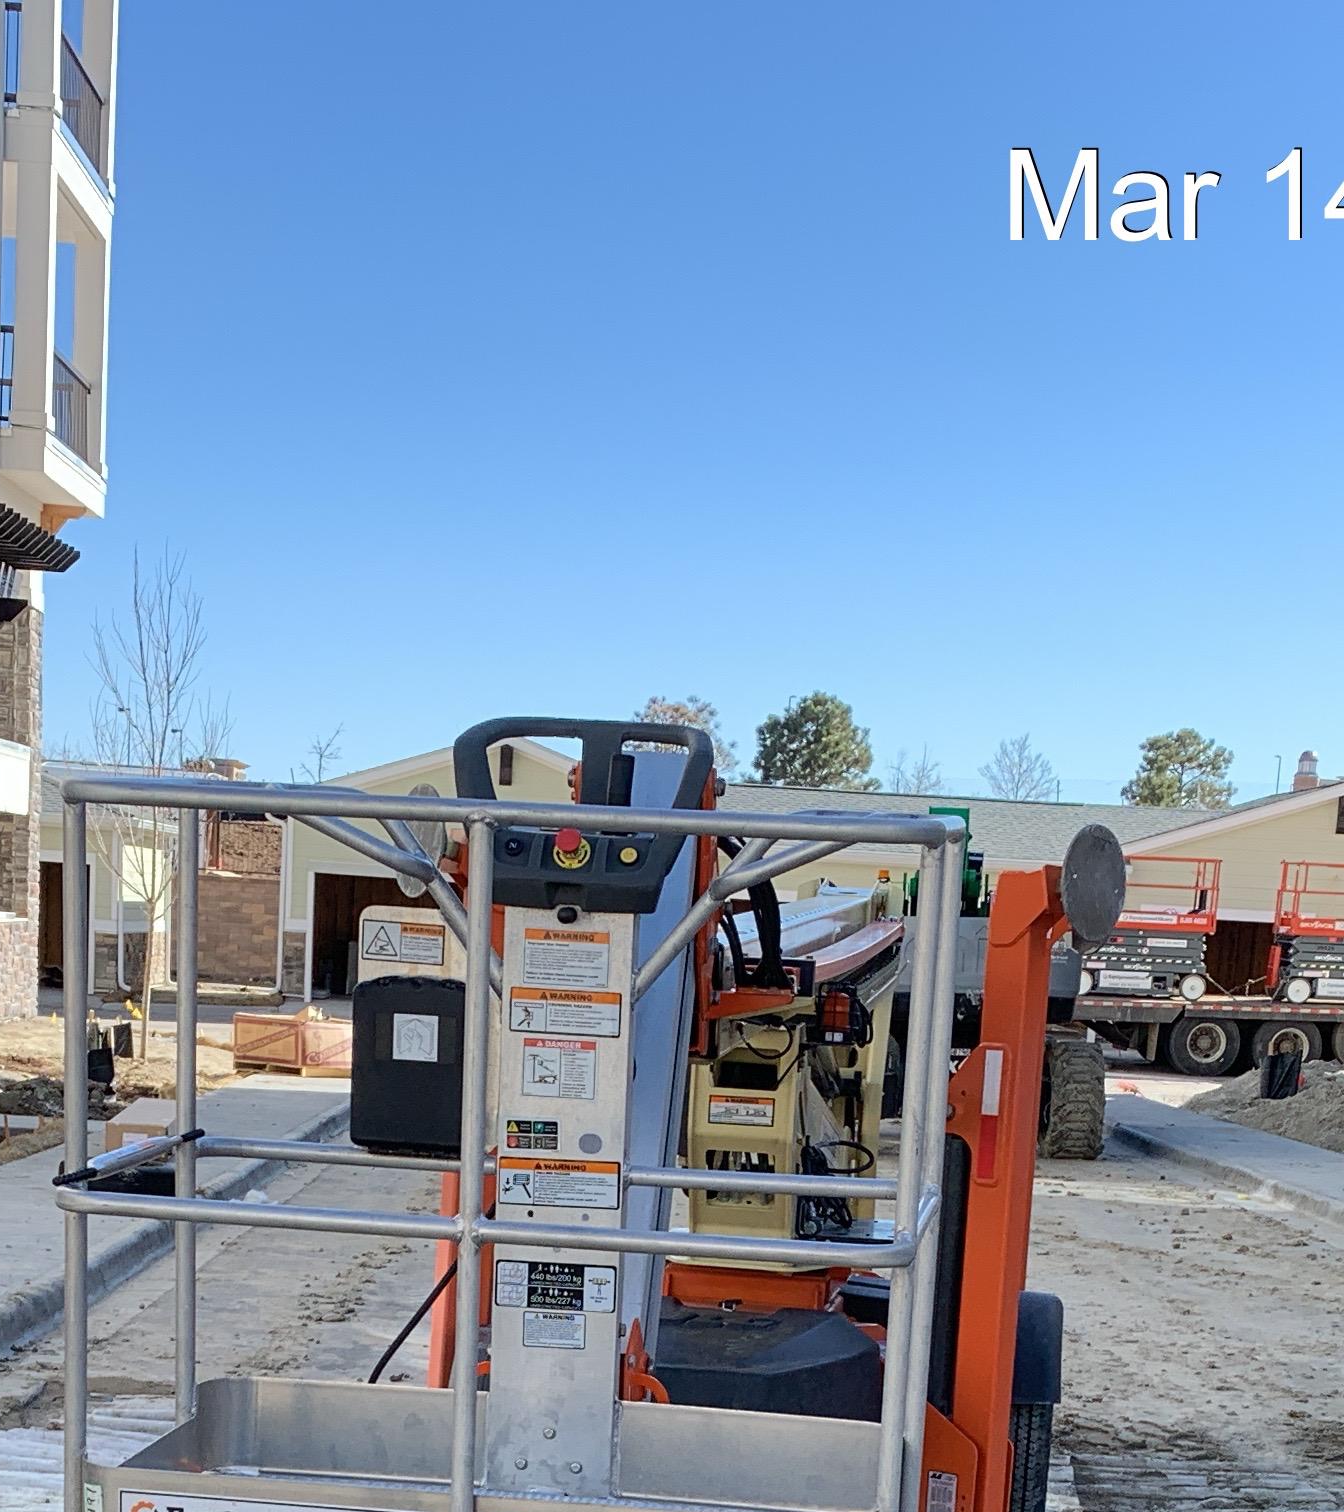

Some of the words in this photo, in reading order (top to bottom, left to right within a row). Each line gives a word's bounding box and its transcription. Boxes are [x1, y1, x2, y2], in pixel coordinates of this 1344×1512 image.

[551, 933, 595, 942] WARNING
[549, 993, 593, 1002] WARNING
[545, 1040, 582, 1049] DANGER
[544, 1163, 587, 1172] WARNING
